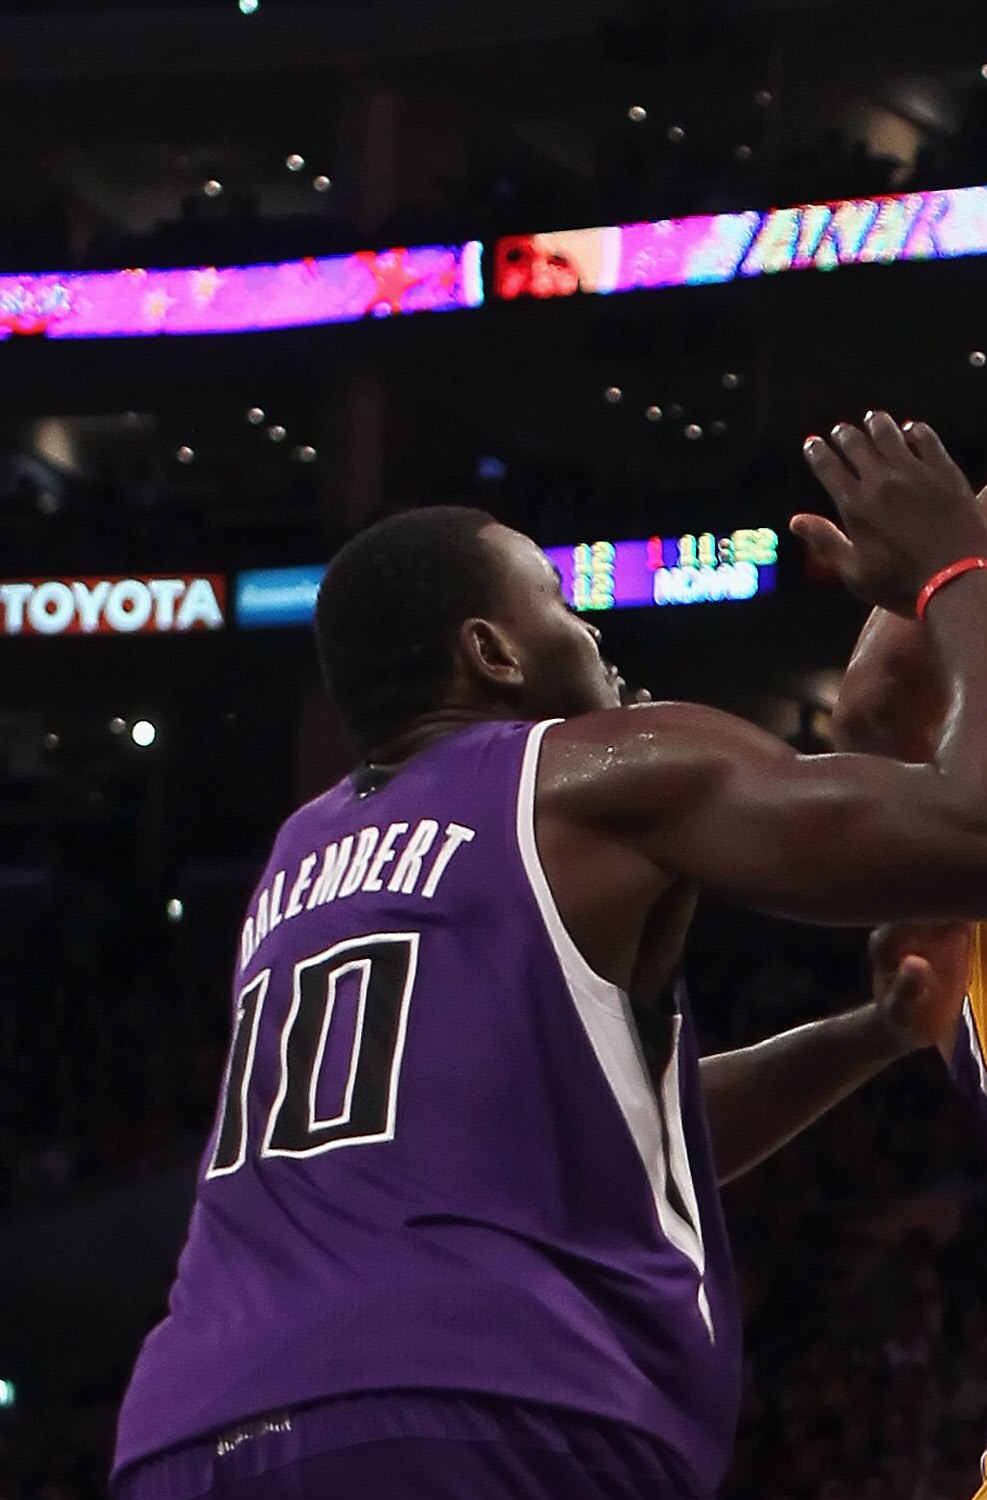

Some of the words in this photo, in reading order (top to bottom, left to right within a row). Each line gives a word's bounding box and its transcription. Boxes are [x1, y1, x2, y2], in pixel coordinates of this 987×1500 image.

[0, 578, 224, 634] TOYOTA
[240, 818, 476, 970] DALEMBERT
[205, 932, 420, 1180] 10
